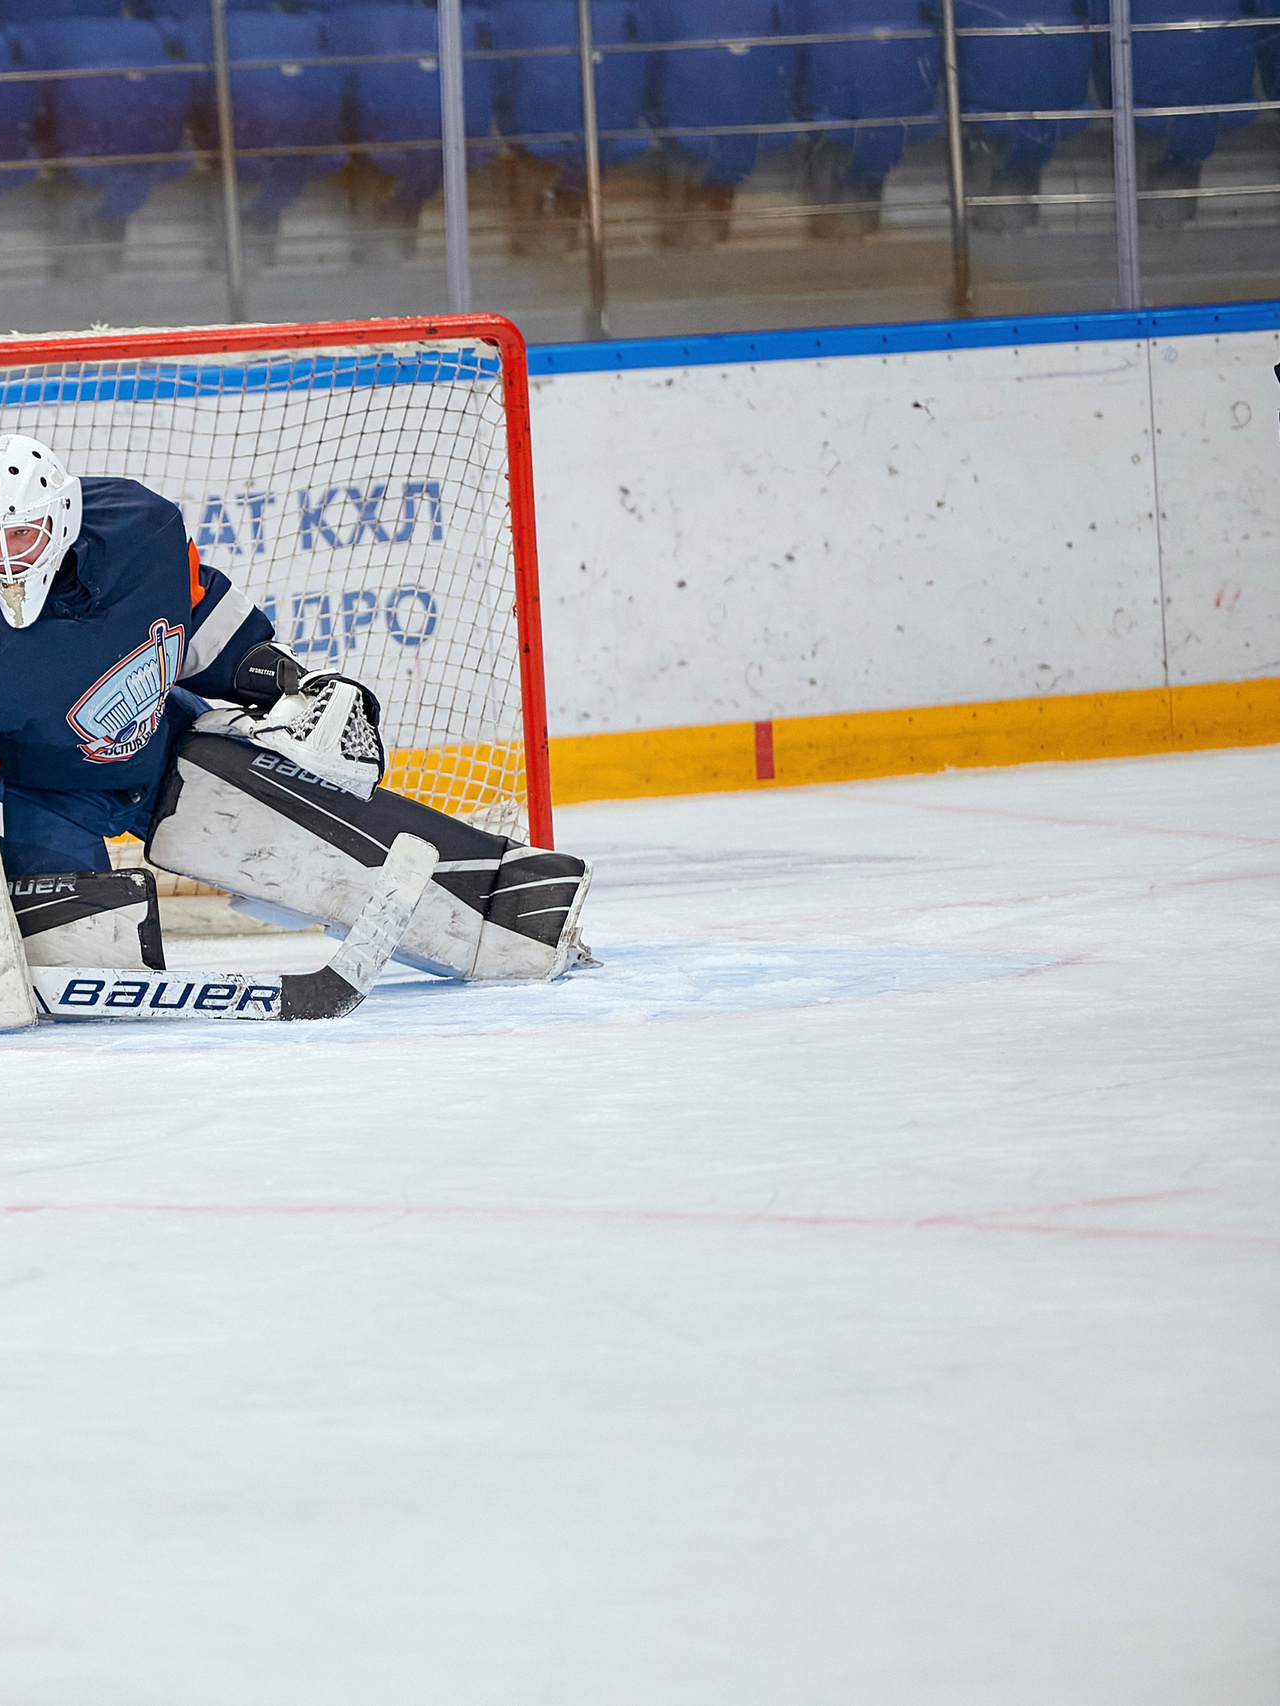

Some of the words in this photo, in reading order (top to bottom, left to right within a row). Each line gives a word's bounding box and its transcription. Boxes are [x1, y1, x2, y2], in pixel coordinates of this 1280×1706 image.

[297, 481, 444, 550] КХЛ
[8, 876, 77, 896] UER
[57, 978, 283, 1013] BAUER
